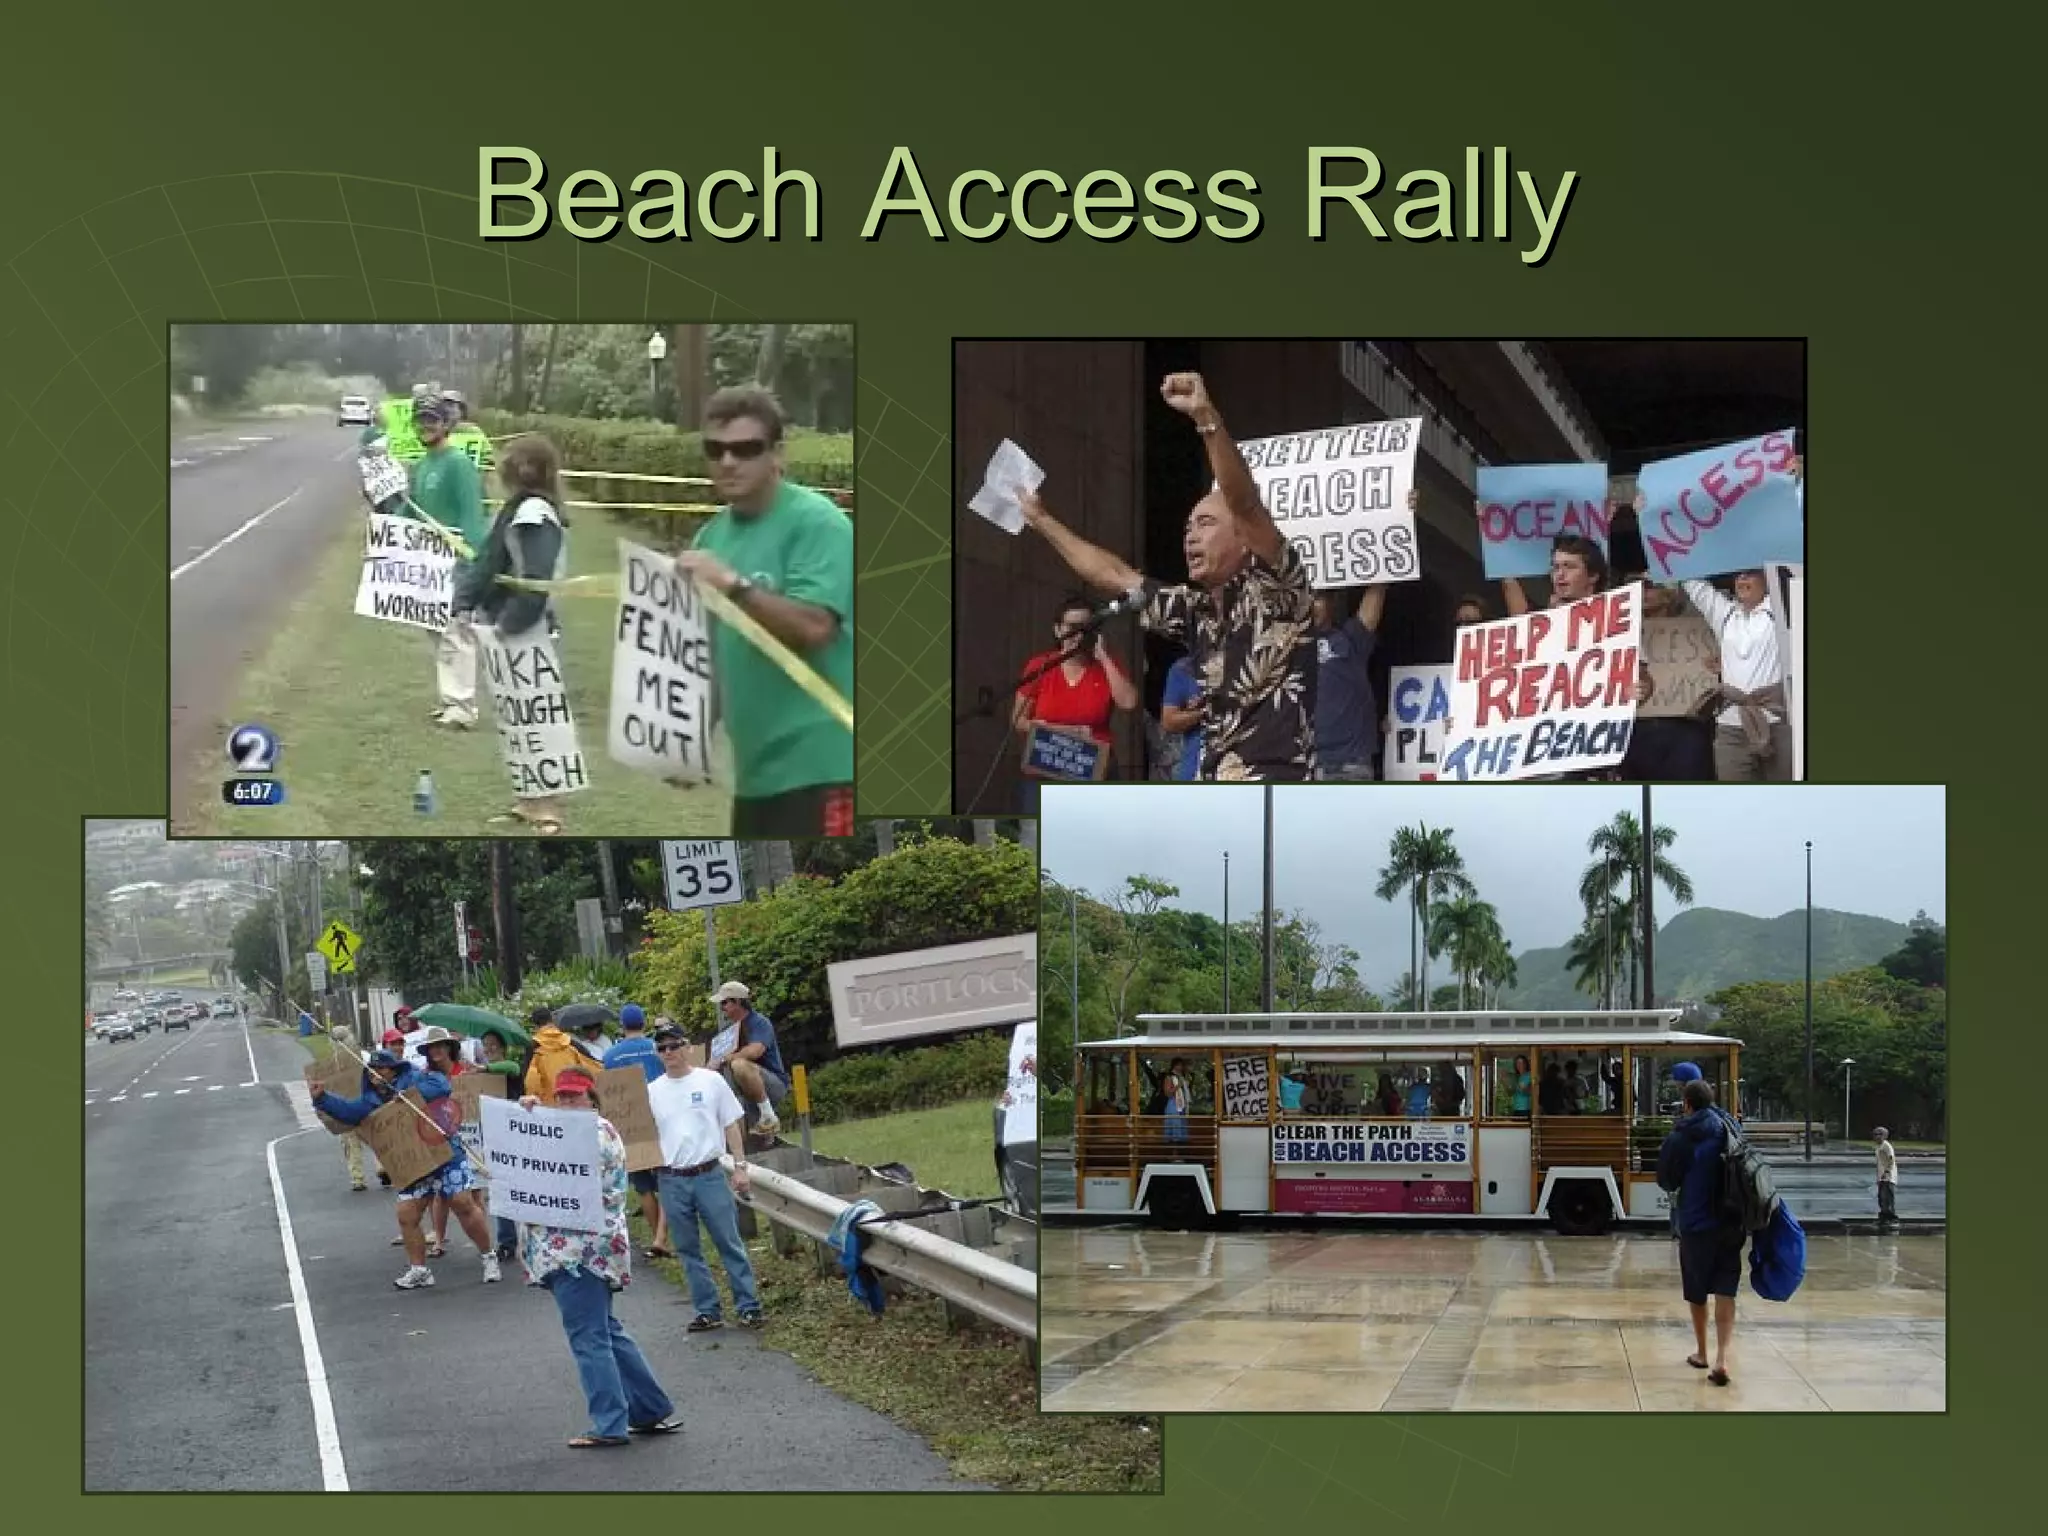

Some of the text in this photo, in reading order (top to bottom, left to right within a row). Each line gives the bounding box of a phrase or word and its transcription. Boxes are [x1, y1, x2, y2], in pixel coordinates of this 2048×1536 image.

[1267, 466, 1394, 520] EACH
[1647, 431, 1796, 577] ACCESS
[370, 518, 398, 548] WE
[1481, 500, 1610, 542] OCEAN
[1290, 525, 1415, 583] CESS
[374, 590, 449, 628] WORKERS
[619, 603, 711, 680] FENCE
[1458, 591, 1631, 682] HELP ME
[637, 667, 692, 721] ME
[1395, 674, 1450, 723] CA
[1475, 646, 1637, 728] REACH
[1441, 719, 1633, 781] THE BEACH
[675, 841, 724, 860] LIMIT
[675, 859, 734, 898] 35
[853, 965, 1031, 1014] PORTLOCK
[1224, 1057, 1269, 1080] FRE
[1225, 1078, 1269, 1101] BEAC
[509, 1119, 564, 1139] PUBLIC
[1274, 1125, 1327, 1141] CLEAR
[1331, 1125, 1364, 1140] THE
[1368, 1125, 1412, 1140] PATH
[491, 1150, 590, 1177] NOT PRIVATE
[1287, 1142, 1366, 1163] BEACH
[1370, 1142, 1466, 1163] ACCESS
[510, 1190, 581, 1210] BEACHES
